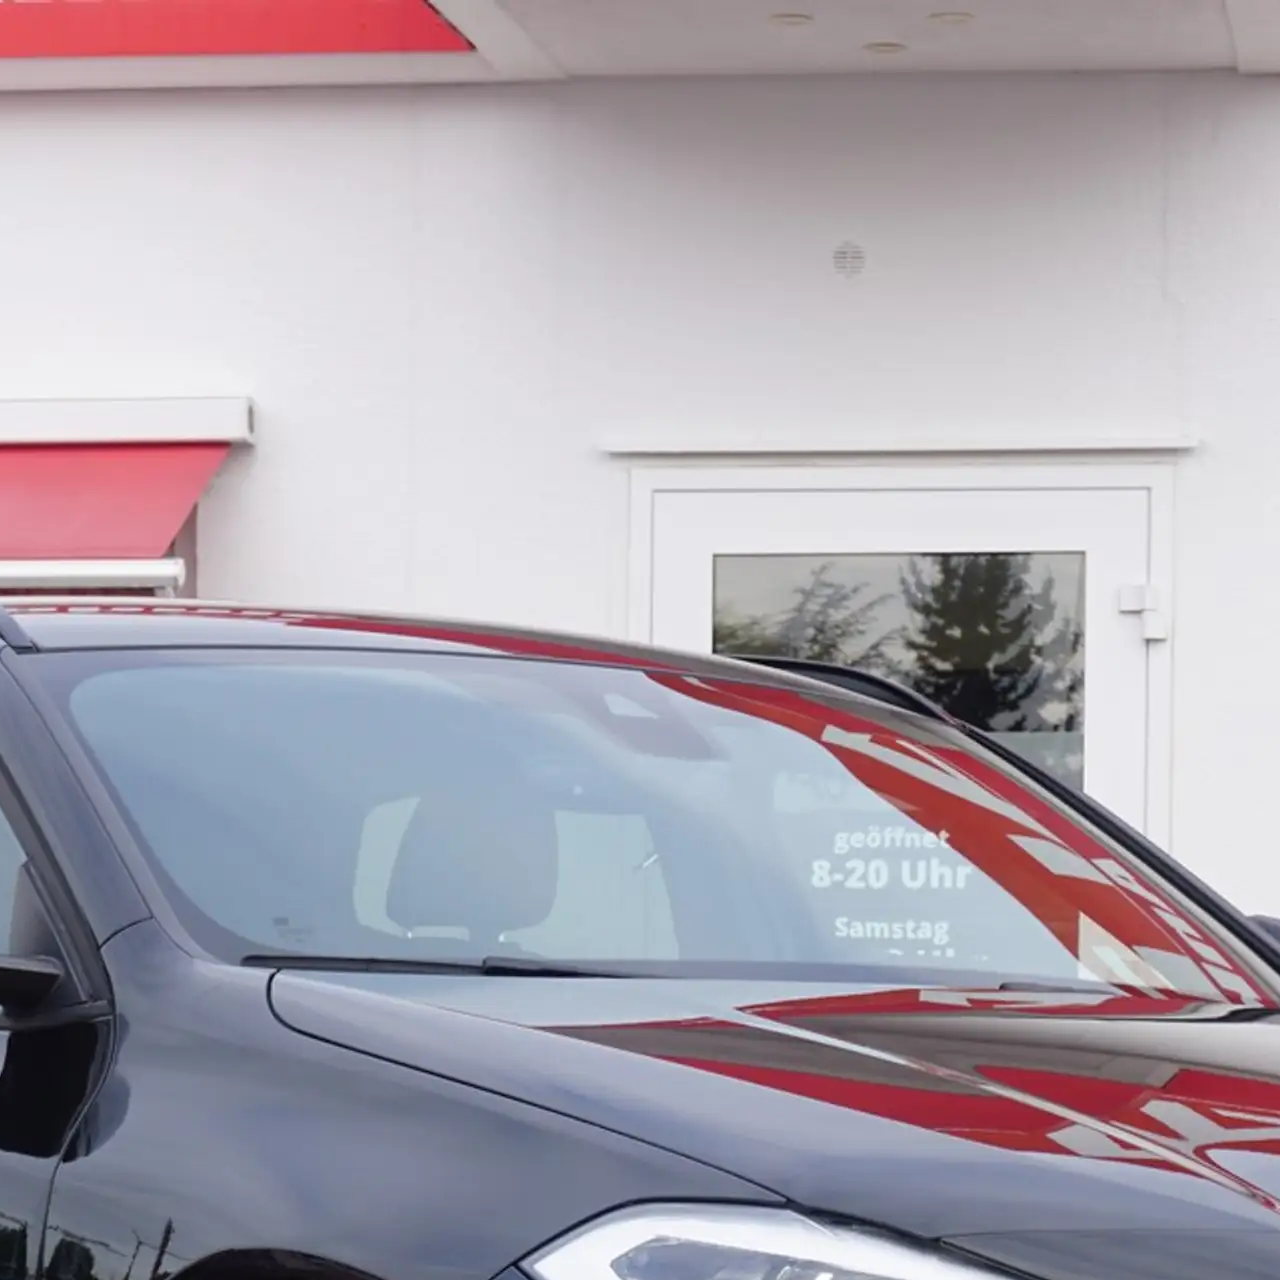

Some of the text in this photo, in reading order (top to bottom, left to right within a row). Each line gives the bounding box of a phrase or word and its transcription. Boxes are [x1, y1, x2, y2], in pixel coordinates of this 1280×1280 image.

[834, 825, 950, 855] geöffnet
[811, 856, 973, 890] 8-20 Uhr
[835, 916, 950, 945] Samstag
